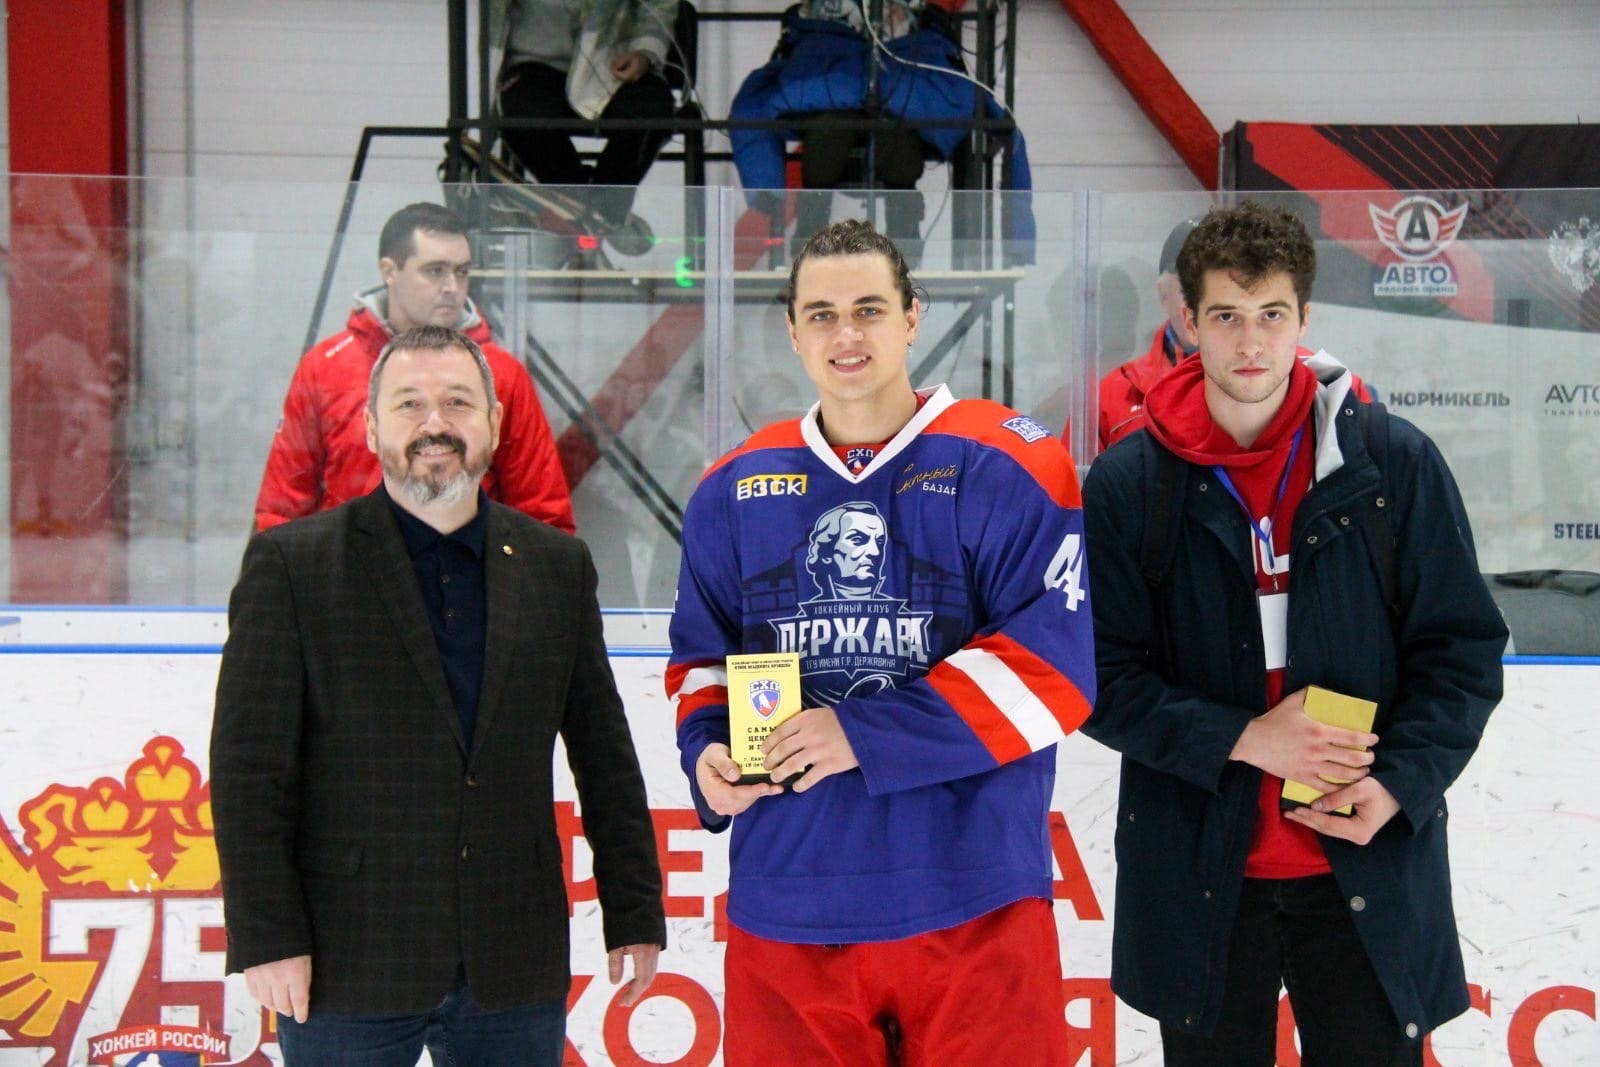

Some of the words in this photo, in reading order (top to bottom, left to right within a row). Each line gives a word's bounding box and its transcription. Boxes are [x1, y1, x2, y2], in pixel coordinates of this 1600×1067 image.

[1386, 265, 1448, 285] АВТО
[1390, 392, 1510, 407] НОРНИКЕЛЬ
[814, 602, 863, 615] ХОККЕЙНЫЙ
[867, 603, 890, 614] КЛУБ
[92, 1028, 157, 1058] ХОККЕЙ
[162, 1031, 227, 1055] РОССИИ
